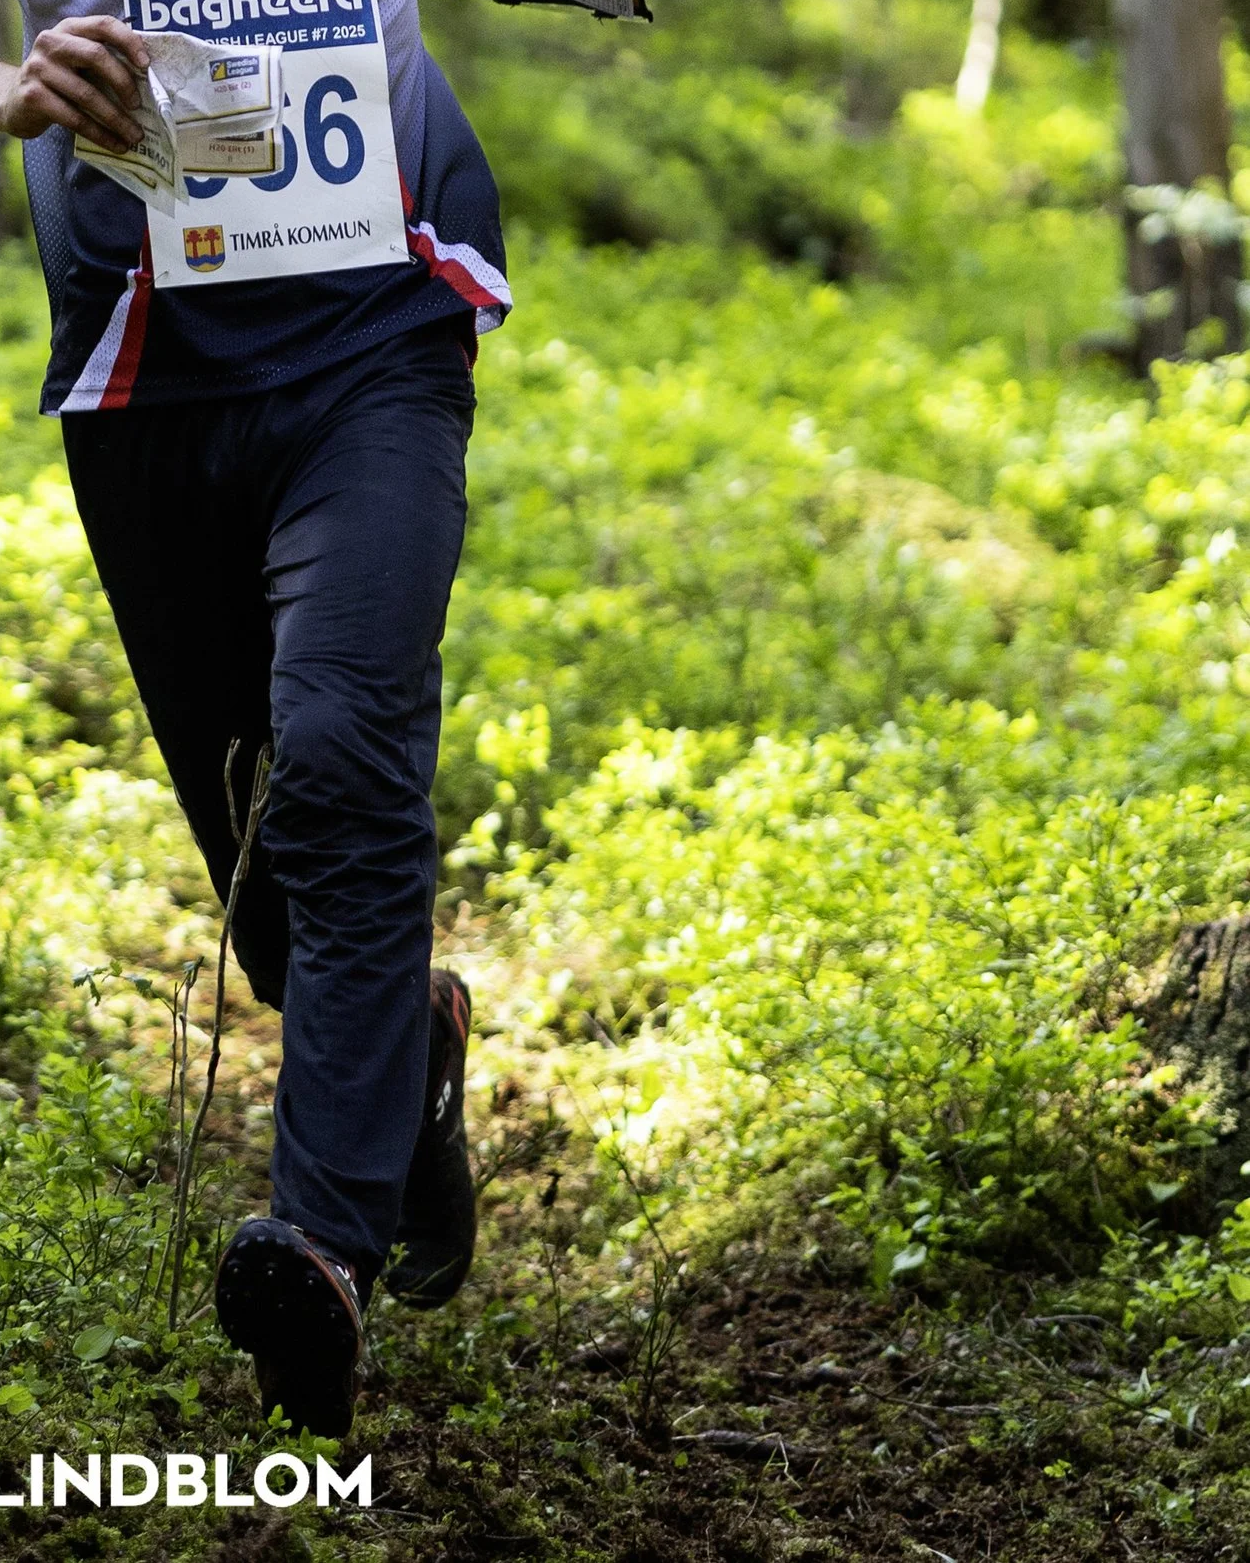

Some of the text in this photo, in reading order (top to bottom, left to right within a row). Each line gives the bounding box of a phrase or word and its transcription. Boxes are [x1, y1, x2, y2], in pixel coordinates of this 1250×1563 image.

[245, 29, 308, 47] LEAGUE
[311, 26, 328, 41] #7
[333, 24, 366, 39] 2025
[230, 219, 371, 251] TIMRÅ KOMMUN
